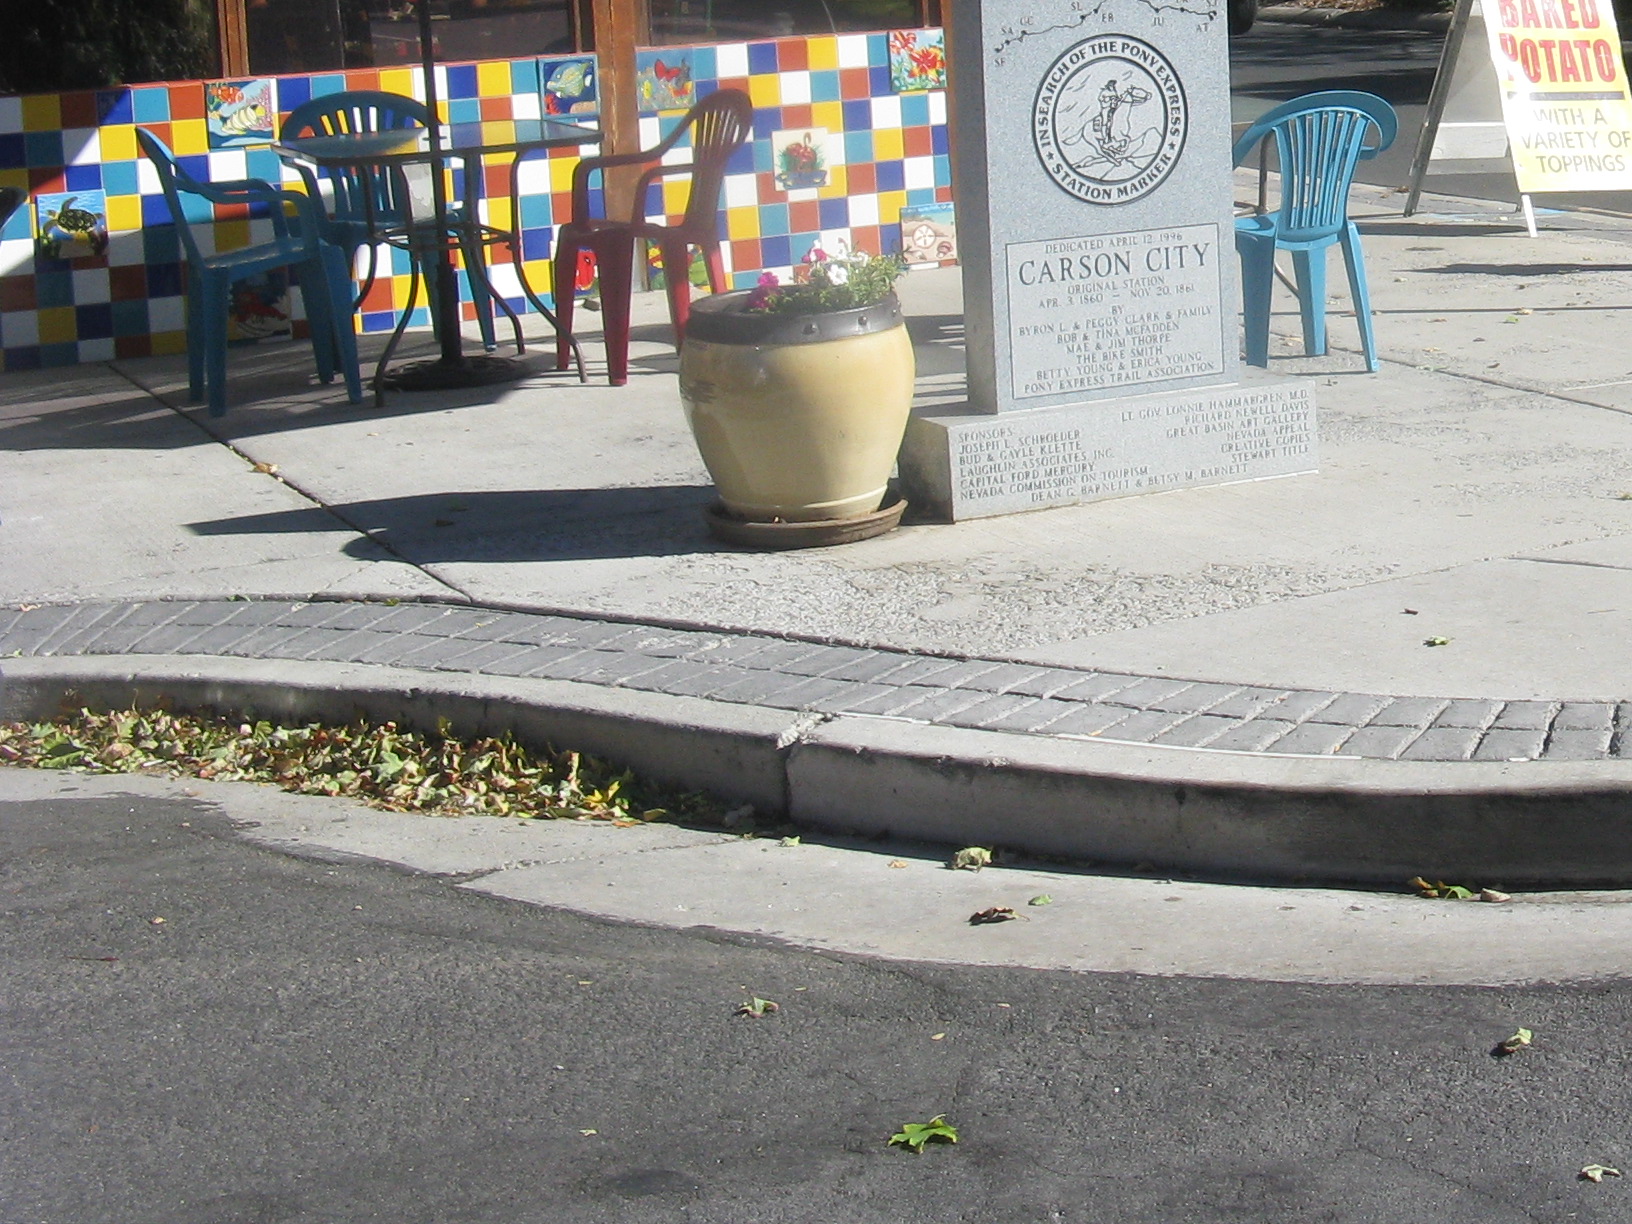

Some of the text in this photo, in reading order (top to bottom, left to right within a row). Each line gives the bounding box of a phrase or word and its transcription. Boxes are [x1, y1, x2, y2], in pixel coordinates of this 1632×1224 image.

[1499, 33, 1616, 83] POTATO
[1038, 41, 1181, 147] IN SEARCH OF THE PONY EXPRESS
[1533, 108, 1608, 126] WITH A
[1521, 131, 1632, 149] VARIETY OF
[1052, 153, 1171, 199] STATION MARKER
[1536, 155, 1626, 173] TOPPINGS
[1045, 239, 1104, 254] DEDICATED
[1109, 236, 1138, 246] APRIL
[1018, 242, 1210, 285] CARSON CITY
[1067, 276, 1165, 294] ORIGINAL STATION
[1019, 323, 1054, 336] BYRON
[1073, 321, 1080, 330] &
[1086, 316, 1119, 329] PEGGY
[1124, 312, 1160, 324] CLARK
[1165, 311, 1172, 320] &
[1177, 305, 1212, 318] FAMILY
[1111, 304, 1124, 315] BY
[1057, 333, 1077, 344] BOB
[1082, 332, 1090, 341] &
[1096, 328, 1120, 339] TINA
[1066, 333, 1171, 354] MAE & JIM THORPE
[1036, 351, 1202, 380] BETTY YOUNG & ERICA YOUNG
[1076, 345, 1163, 364] THE BIKE SMITH
[1024, 361, 1214, 394] PONY EXPRESS TRAIL ASSOCIATION
[1166, 411, 1309, 439] GREAT BASIN ART GALLERY
[1185, 400, 1309, 425] RICHARD NEWELL DAVIS
[959, 440, 999, 455] JOSEPH
[1019, 429, 1080, 447] SCHROEDER
[1220, 433, 1310, 453] CREATIVE COPIES
[1226, 421, 1310, 442] NEVADA APPEAL
[959, 440, 1081, 465] BUD & GAYLE KLETTE
[1231, 444, 1309, 463] STEWART TITLE
[960, 461, 1015, 478] LAUGHLIN
[960, 461, 1095, 489] CAPITAL FORD MERCURY
[961, 465, 1148, 501] NEVADA COMMISSION ON TOURISM
[1031, 490, 1061, 503] DEAN
[1081, 479, 1129, 495] BARNETT
[1135, 479, 1143, 488] &
[1148, 473, 1180, 486] BETSY
[1200, 463, 1248, 478] BARNETT
